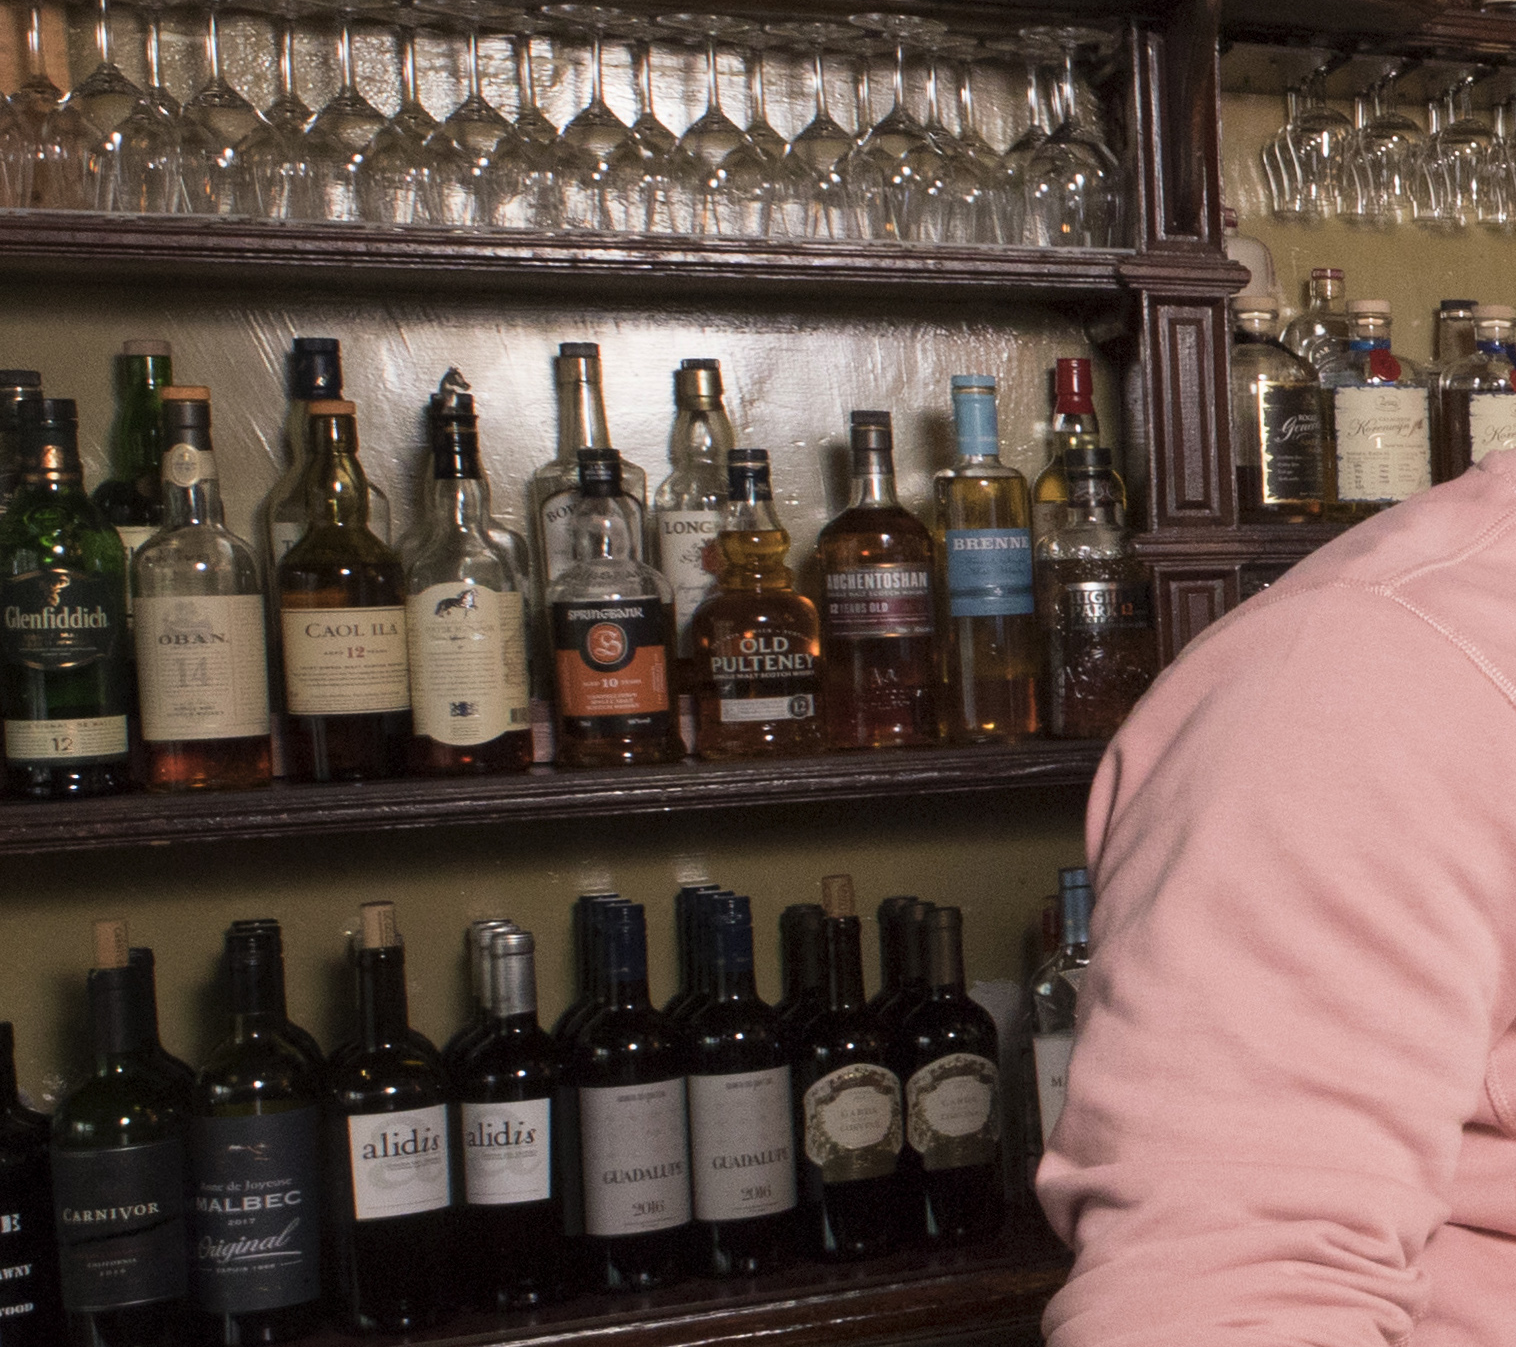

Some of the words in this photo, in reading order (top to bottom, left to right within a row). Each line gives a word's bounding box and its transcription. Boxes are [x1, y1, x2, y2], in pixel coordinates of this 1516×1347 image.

[952, 536, 1030, 551] BRENNE
[826, 571, 928, 591] AUCHENTOSHAN
[567, 606, 645, 621] SPRINGBANK
[869, 603, 889, 613] OLD
[4, 606, 109, 630] Glenfiddich
[304, 622, 366, 639] CAOL
[158, 633, 227, 646] OBAN
[739, 636, 789, 653] OLD
[346, 646, 366, 659] 12
[711, 653, 815, 673] PULTENEY
[602, 677, 619, 688] 10
[791, 700, 808, 714] 12
[51, 736, 74, 752] 12
[467, 1120, 537, 1148] alidis
[362, 1127, 440, 1160] alidis
[226, 1181, 242, 1192] de
[739, 1183, 772, 1201] 2016
[196, 1190, 301, 1214] MALBEC
[632, 1200, 666, 1216] 2016
[61, 1202, 160, 1224] CARNIVOR
[227, 1217, 256, 1227] 2017
[199, 1217, 301, 1263] Original
